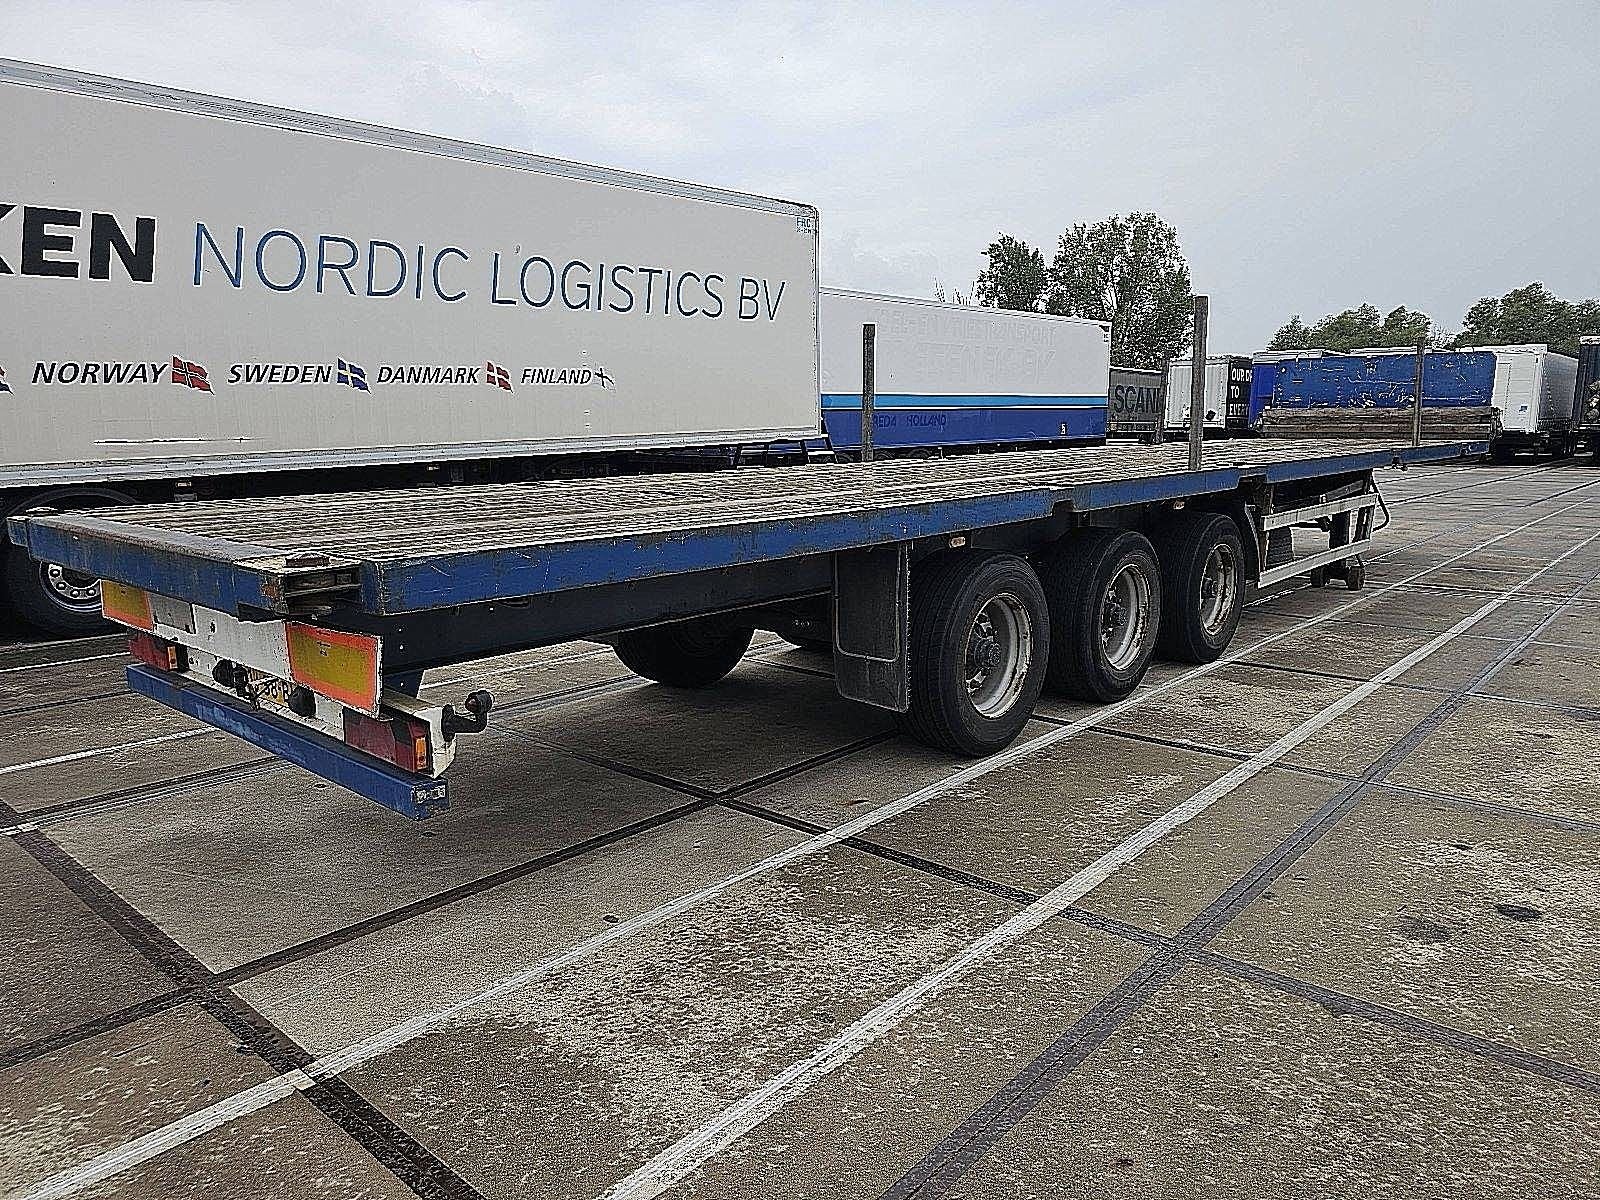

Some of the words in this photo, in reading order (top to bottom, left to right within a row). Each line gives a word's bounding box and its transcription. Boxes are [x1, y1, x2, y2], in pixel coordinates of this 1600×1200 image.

[193, 222, 470, 301] NORDIC
[491, 252, 724, 319] LOGISTICS
[738, 277, 786, 321] BV
[31, 361, 170, 384] NORWAY
[227, 363, 333, 384] SWEDEN
[376, 366, 482, 384] DANMARK
[520, 368, 593, 385] FINLAND
[1231, 368, 1245, 381] OUR
[1230, 385, 1240, 398] TO
